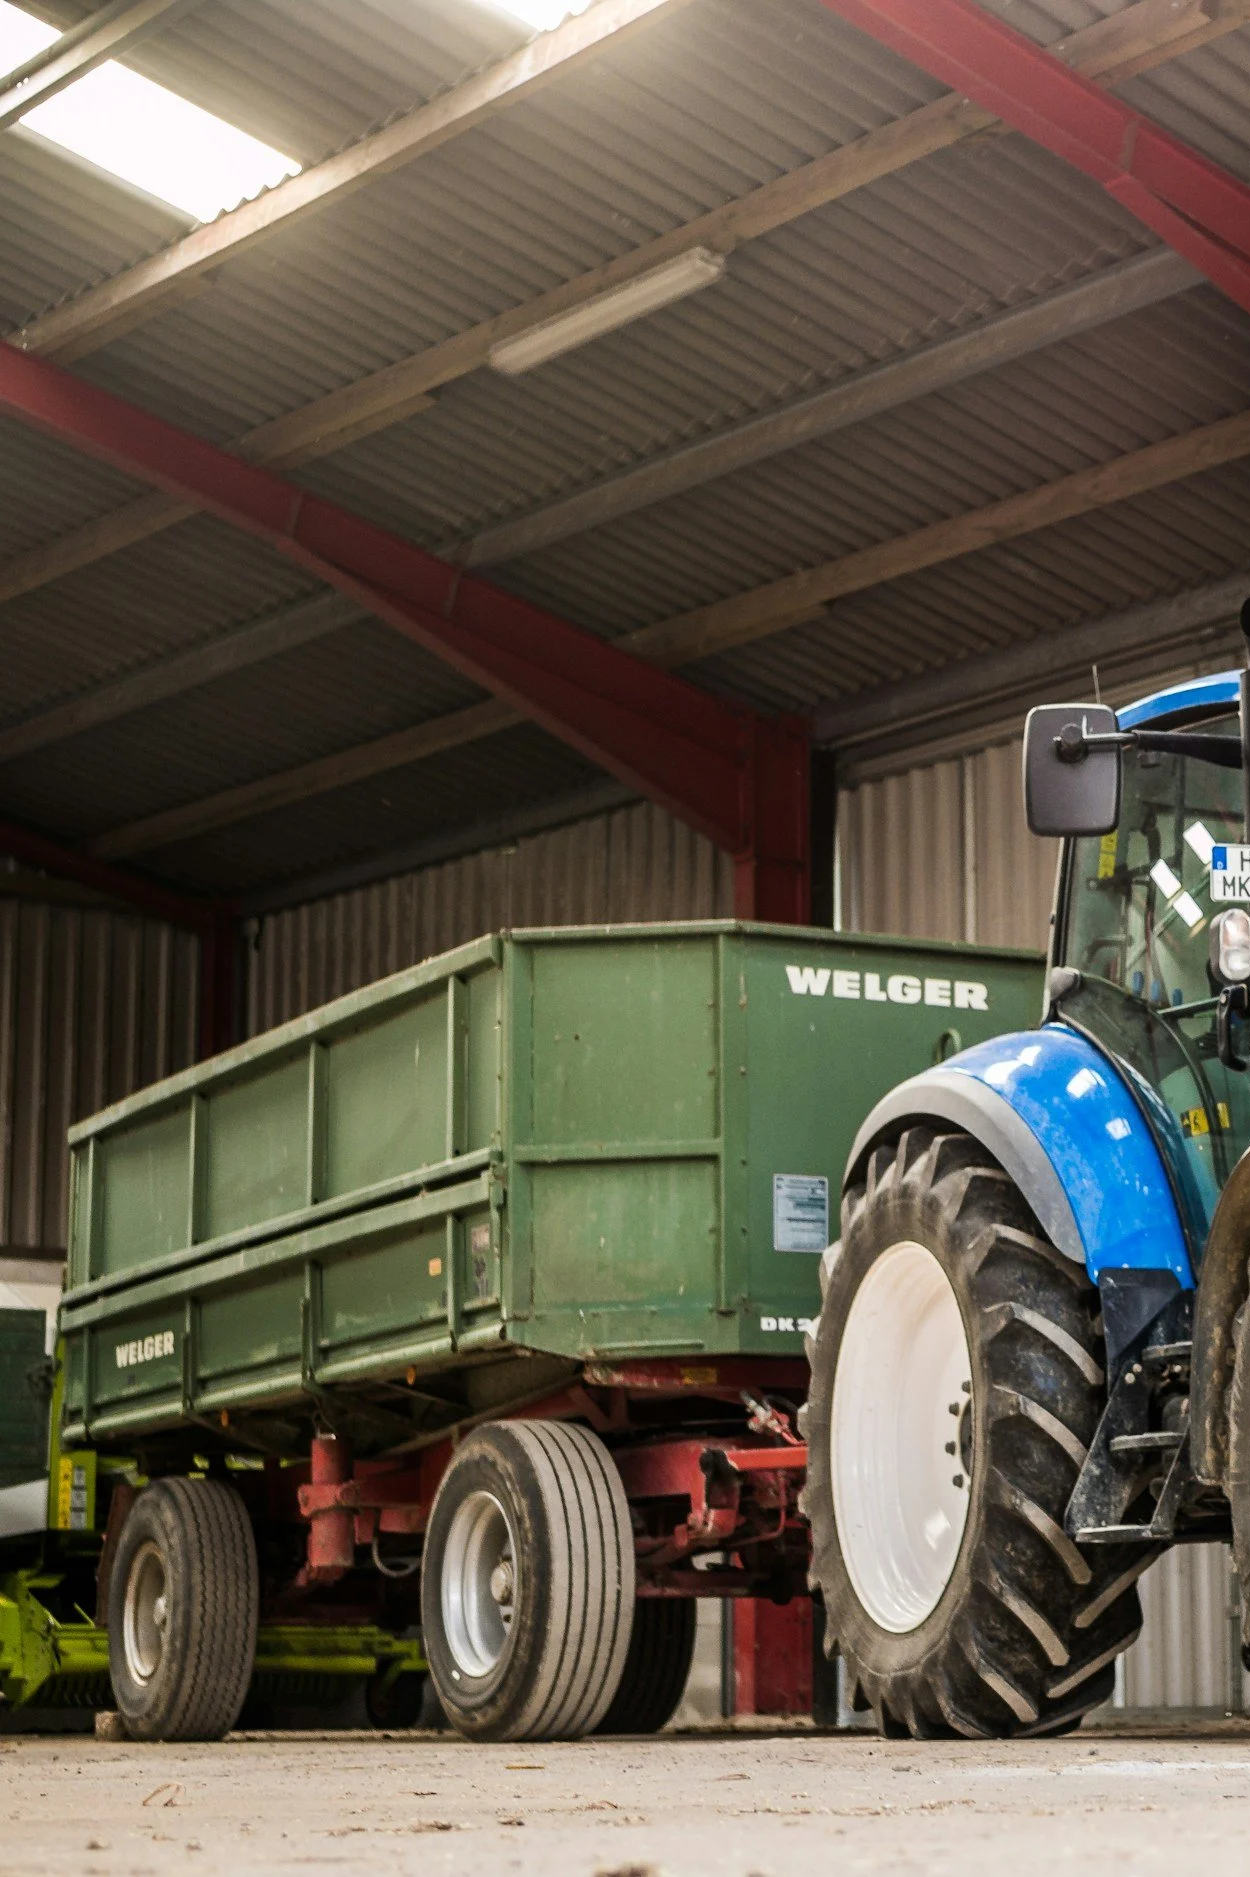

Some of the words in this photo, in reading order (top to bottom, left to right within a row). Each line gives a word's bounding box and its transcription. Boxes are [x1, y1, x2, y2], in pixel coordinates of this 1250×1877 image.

[1223, 875, 1250, 897] MK
[785, 965, 989, 1011] WELGER
[116, 1330, 175, 1369] WELGER
